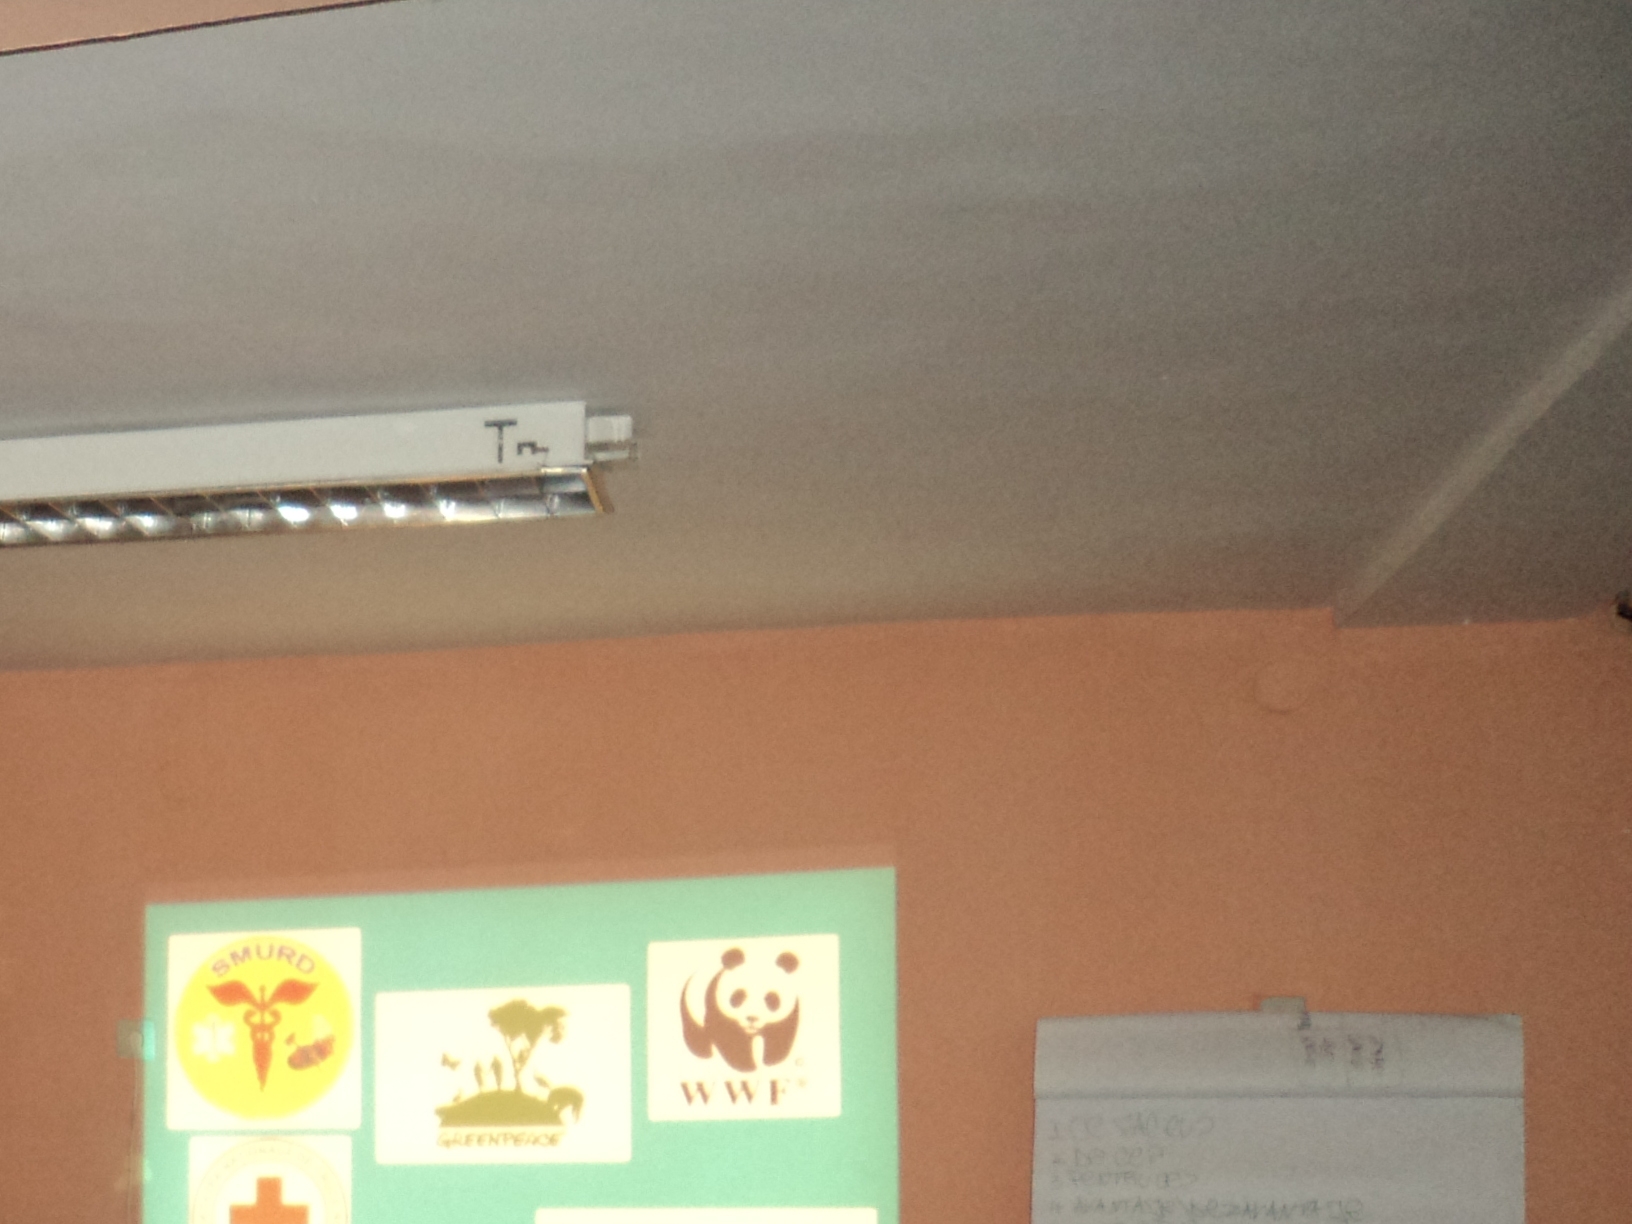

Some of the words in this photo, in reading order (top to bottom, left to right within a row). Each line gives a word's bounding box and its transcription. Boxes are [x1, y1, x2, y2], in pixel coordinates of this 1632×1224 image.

[211, 943, 316, 978] SMURD
[680, 1079, 787, 1106] WWF
[436, 1131, 563, 1149] GREENPEACE
